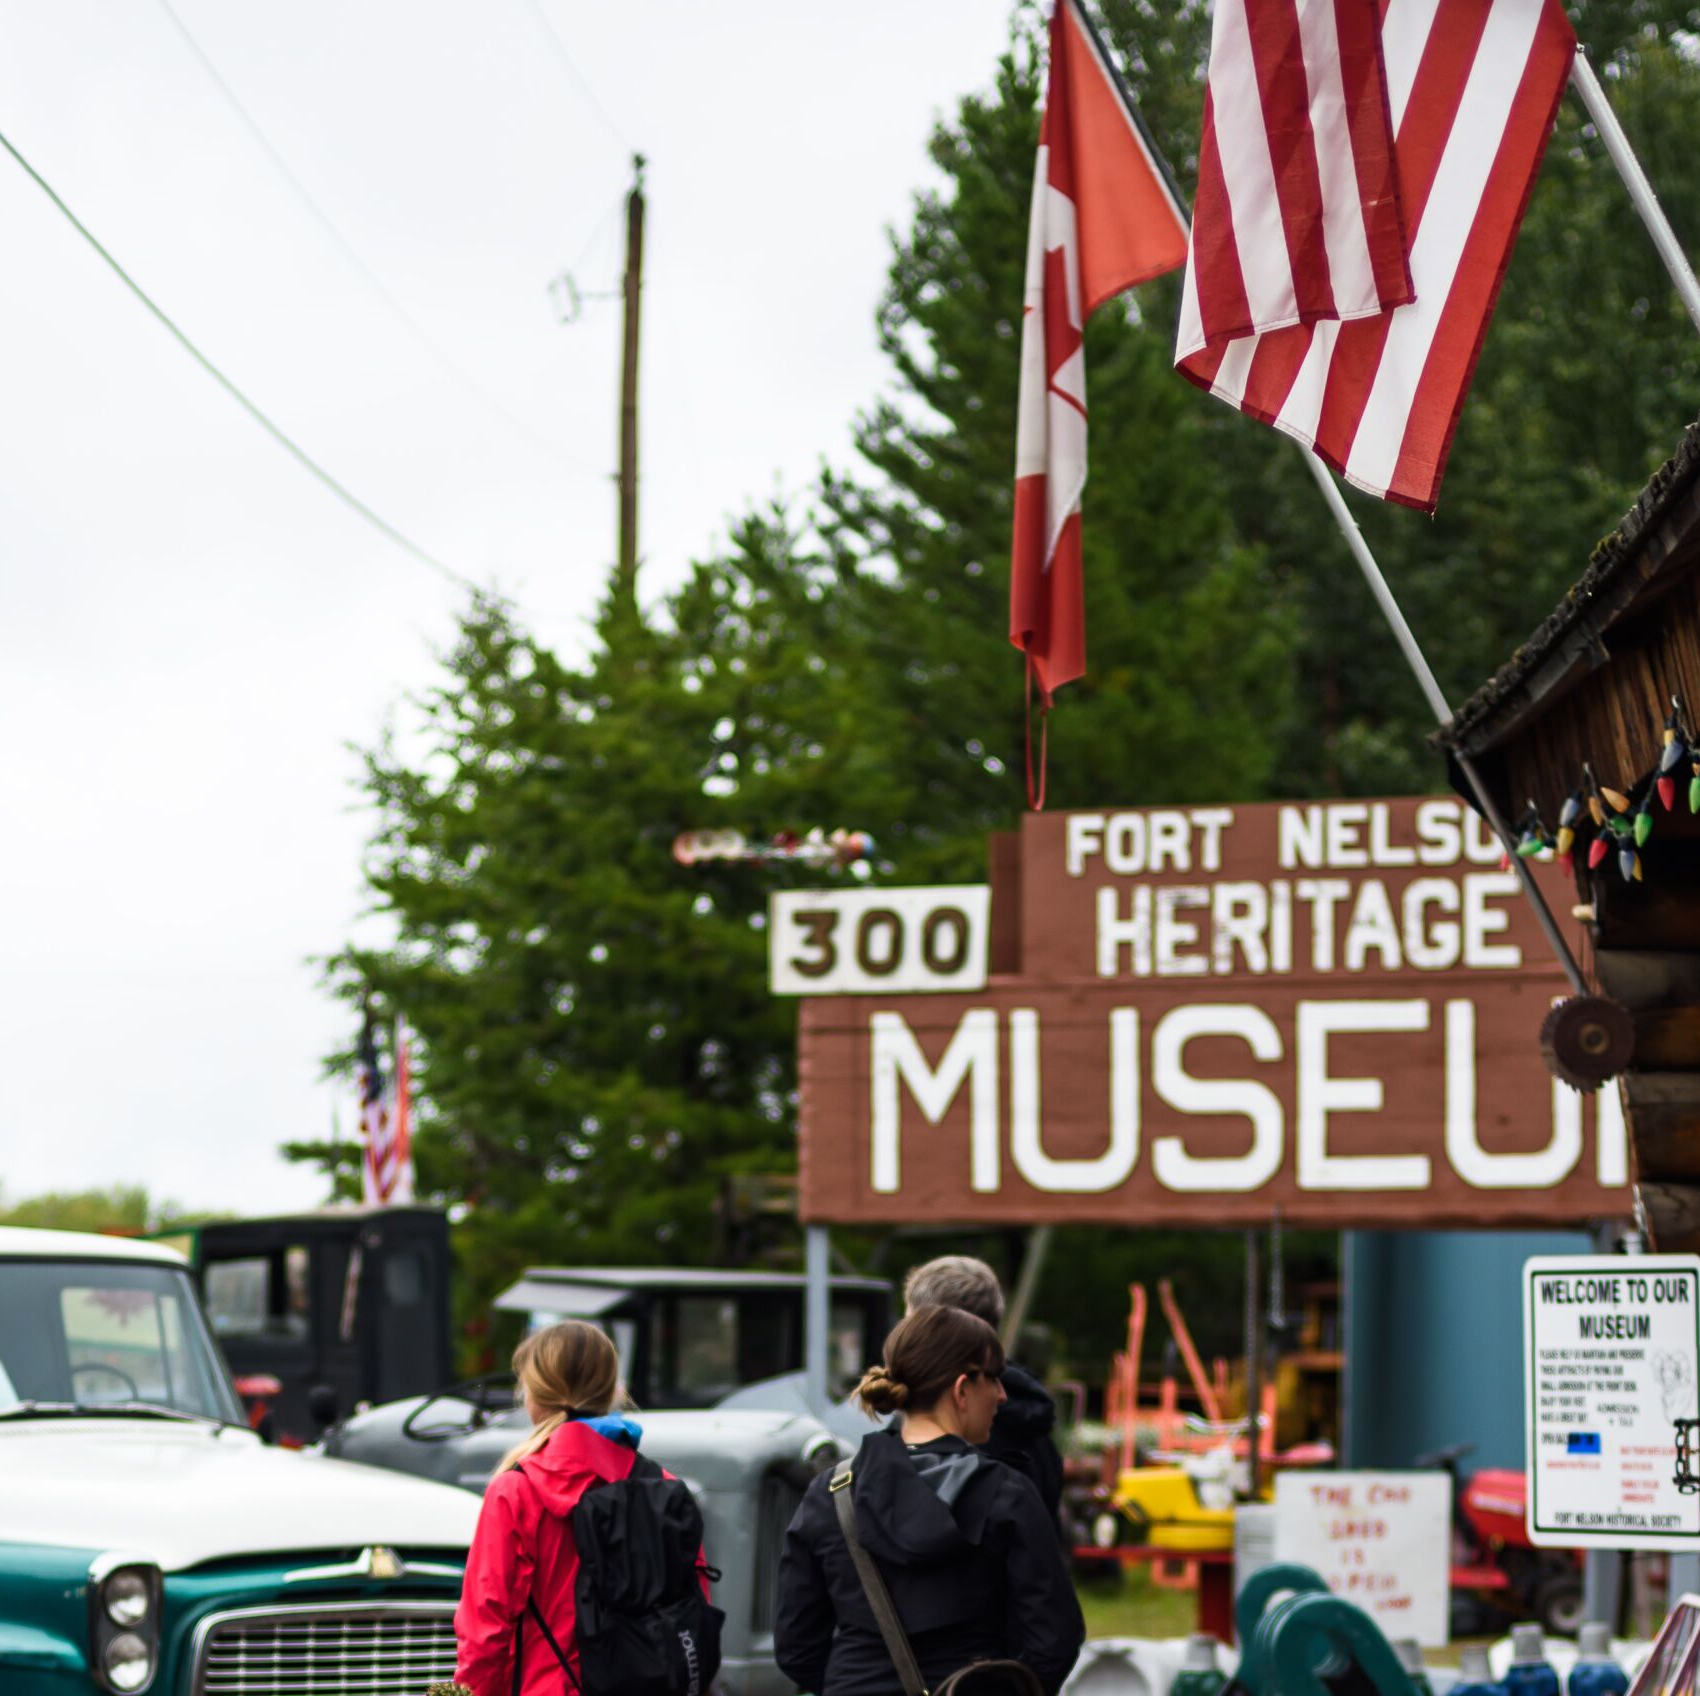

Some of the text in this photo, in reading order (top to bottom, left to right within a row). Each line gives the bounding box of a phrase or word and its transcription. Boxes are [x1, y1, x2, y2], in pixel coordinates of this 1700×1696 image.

[1066, 801, 1506, 877] FORT NELSO
[1097, 872, 1522, 978] HERITAGE
[789, 906, 972, 979] 300
[869, 999, 1629, 1193] MUSEU
[1541, 1278, 1689, 1304] WELCOME TO OUR
[1579, 1314, 1651, 1339] MUSEUM
[1309, 1486, 1351, 1506] THE
[1555, 1512, 1573, 1523] FORT
[1576, 1513, 1603, 1525] NELSON
[1606, 1513, 1647, 1527] HISTORICAL
[1342, 1548, 1365, 1565] IS
